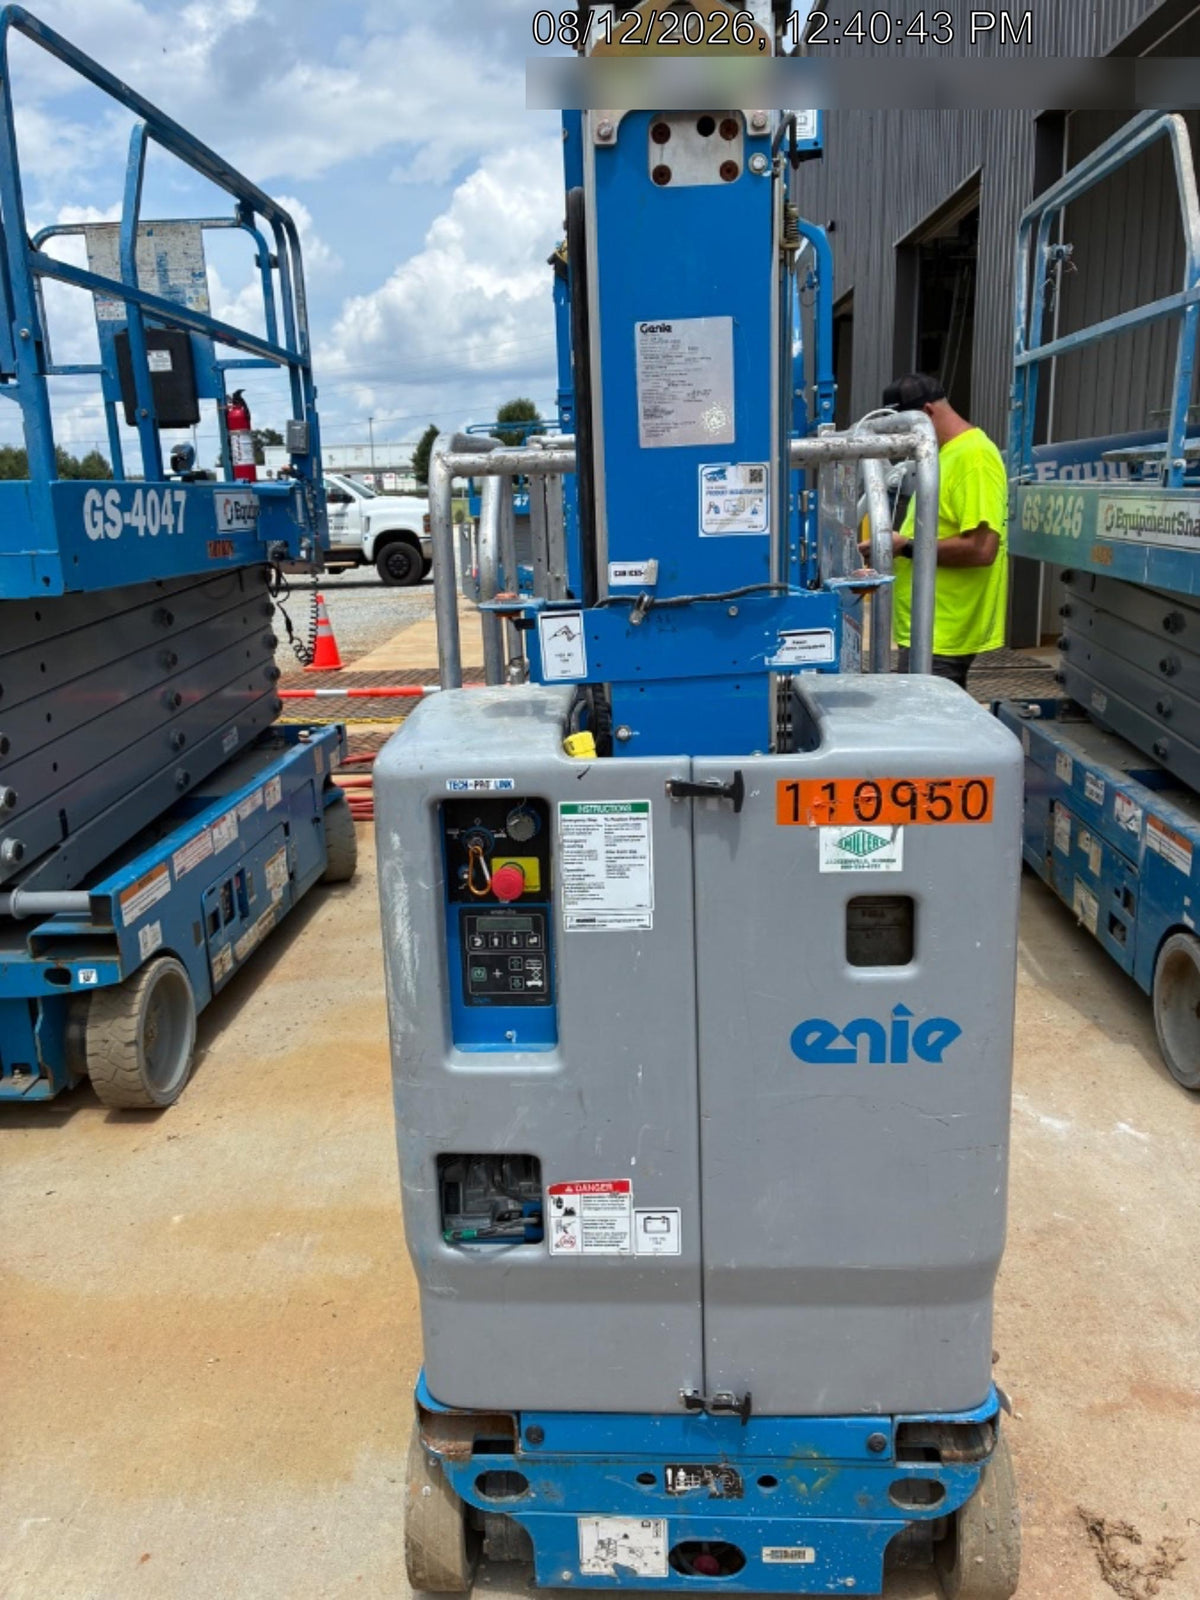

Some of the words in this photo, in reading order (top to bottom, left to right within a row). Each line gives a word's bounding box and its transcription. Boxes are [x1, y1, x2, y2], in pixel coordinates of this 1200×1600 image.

[640, 323, 672, 333] Genie
[83, 488, 187, 541] GS-4047
[1021, 494, 1085, 539] GS-3246
[577, 803, 632, 813] INSTRUCTIONS
[785, 779, 989, 822] 110950
[790, 1002, 963, 1064] enie
[575, 1183, 613, 1193] DANGER
